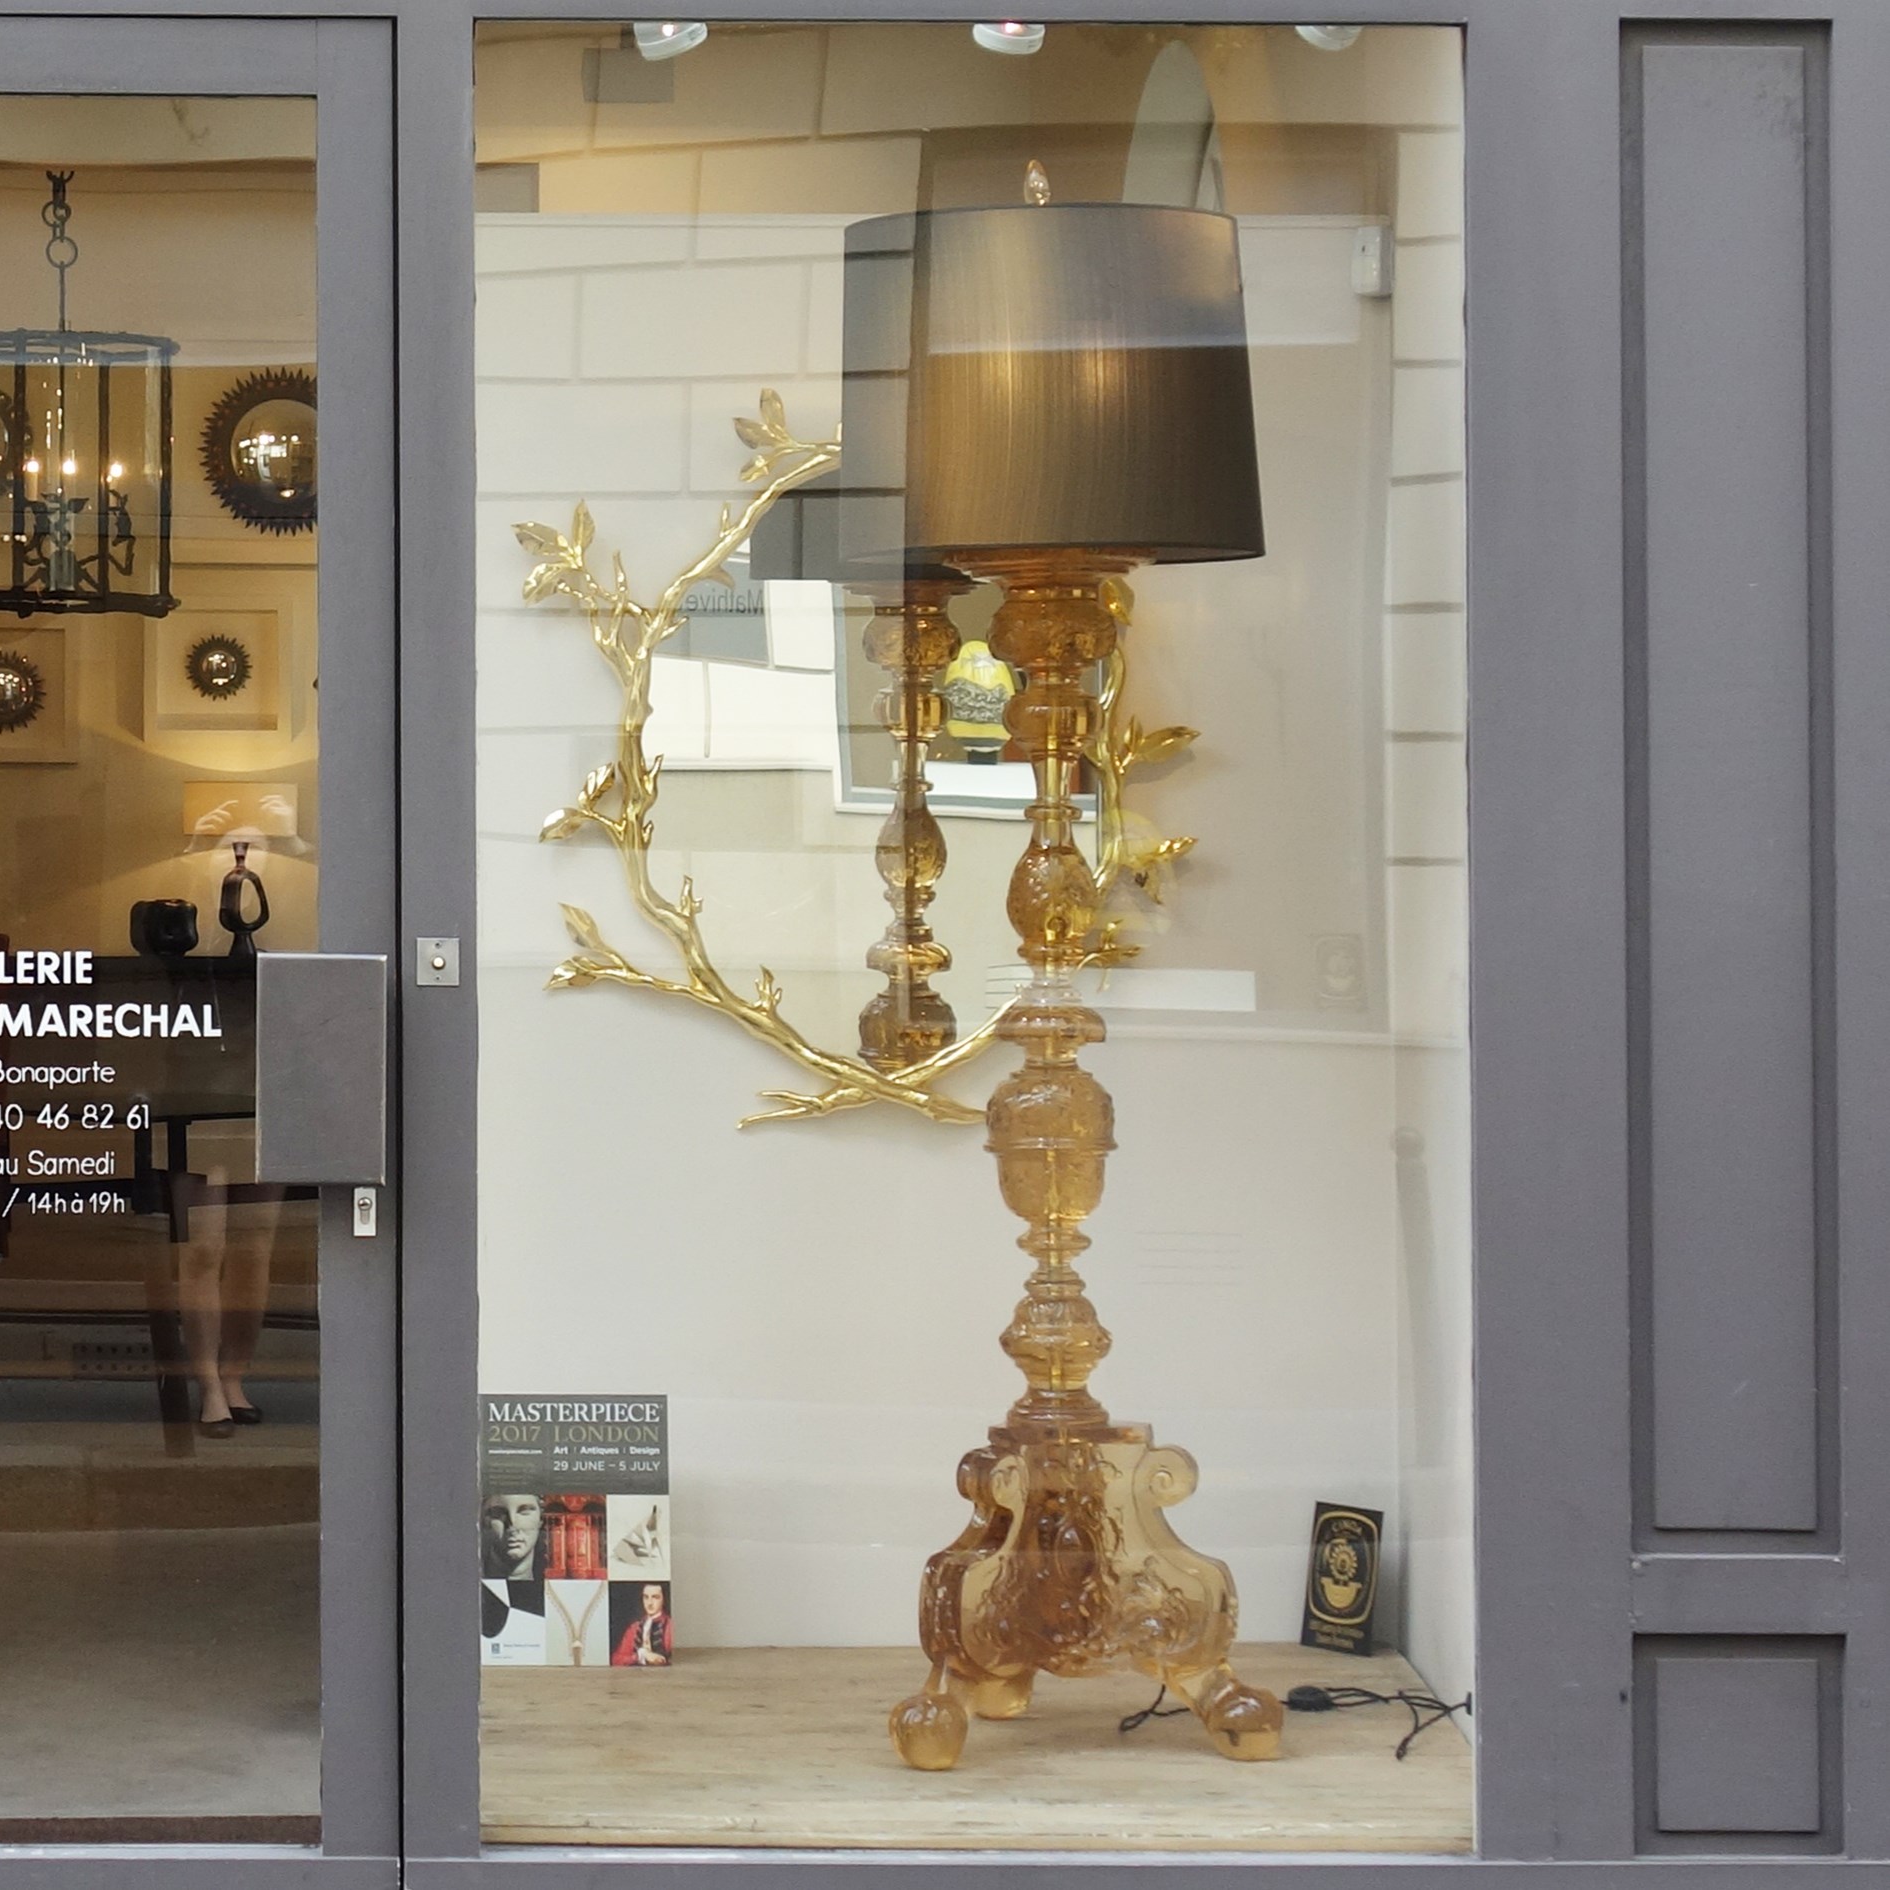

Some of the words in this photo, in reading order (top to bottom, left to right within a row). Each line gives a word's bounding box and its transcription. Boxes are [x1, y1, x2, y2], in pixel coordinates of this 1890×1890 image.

[36, 1103, 70, 1130] 46
[81, 1103, 114, 1130] 82
[126, 1104, 150, 1130] 61
[27, 1149, 115, 1176] Samedi
[488, 1402, 660, 1423] MASTERPIECE
[488, 1424, 541, 1443] 2017
[553, 1424, 660, 1443] LONDON
[553, 1445, 569, 1455] Art
[580, 1445, 620, 1456] Antiques
[629, 1446, 661, 1456] Design
[553, 1460, 569, 1472] 29
[572, 1460, 606, 1472] JUNE
[618, 1460, 627, 1472] 5
[629, 1460, 662, 1472] JULY
